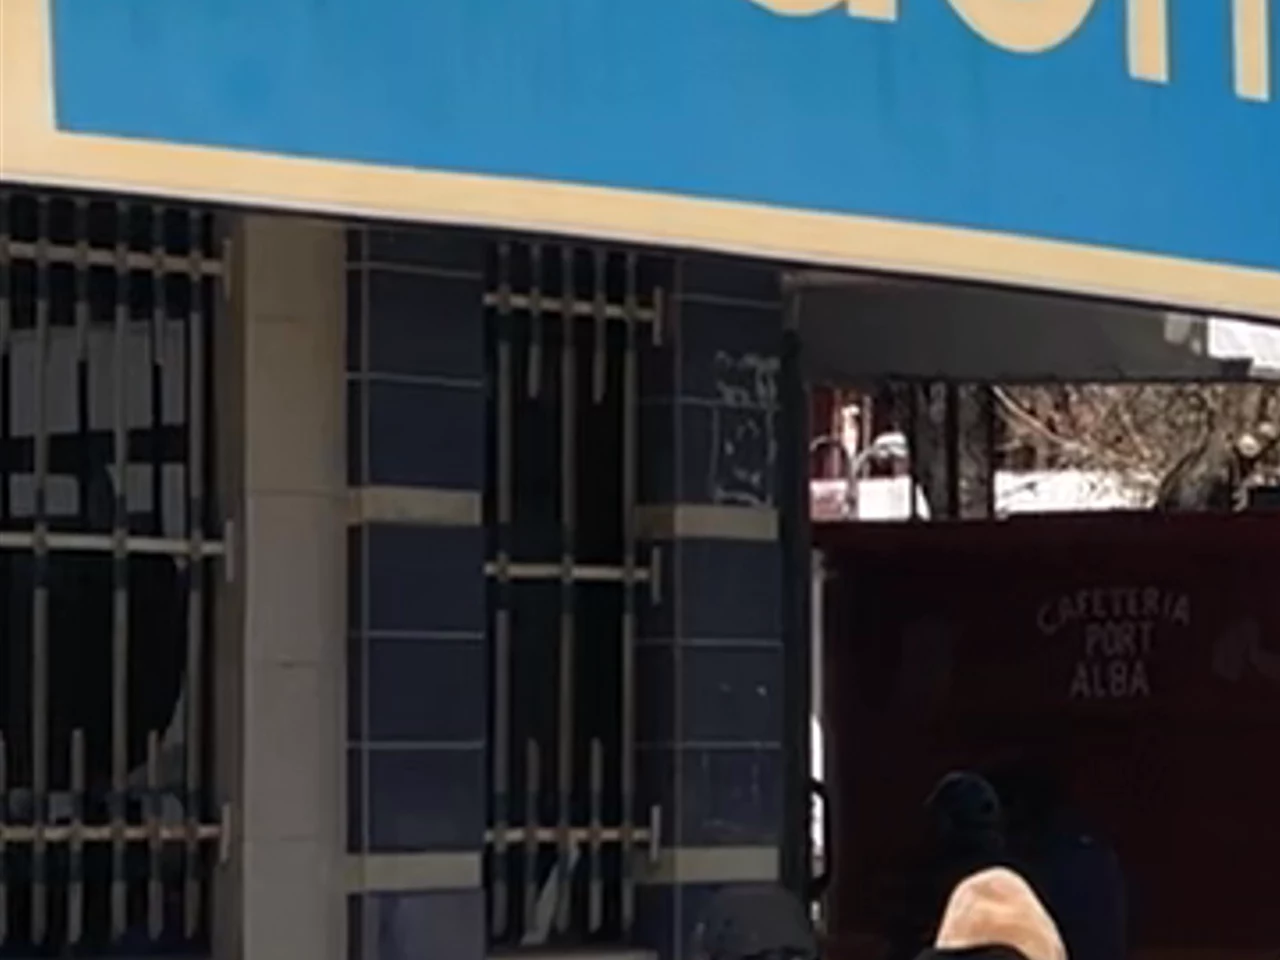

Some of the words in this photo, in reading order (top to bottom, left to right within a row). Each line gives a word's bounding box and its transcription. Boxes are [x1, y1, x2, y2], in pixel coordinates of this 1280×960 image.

[1036, 585, 1191, 636] CAFETERIA
[1084, 619, 1155, 658] PORT
[1070, 659, 1151, 698] ALBA
